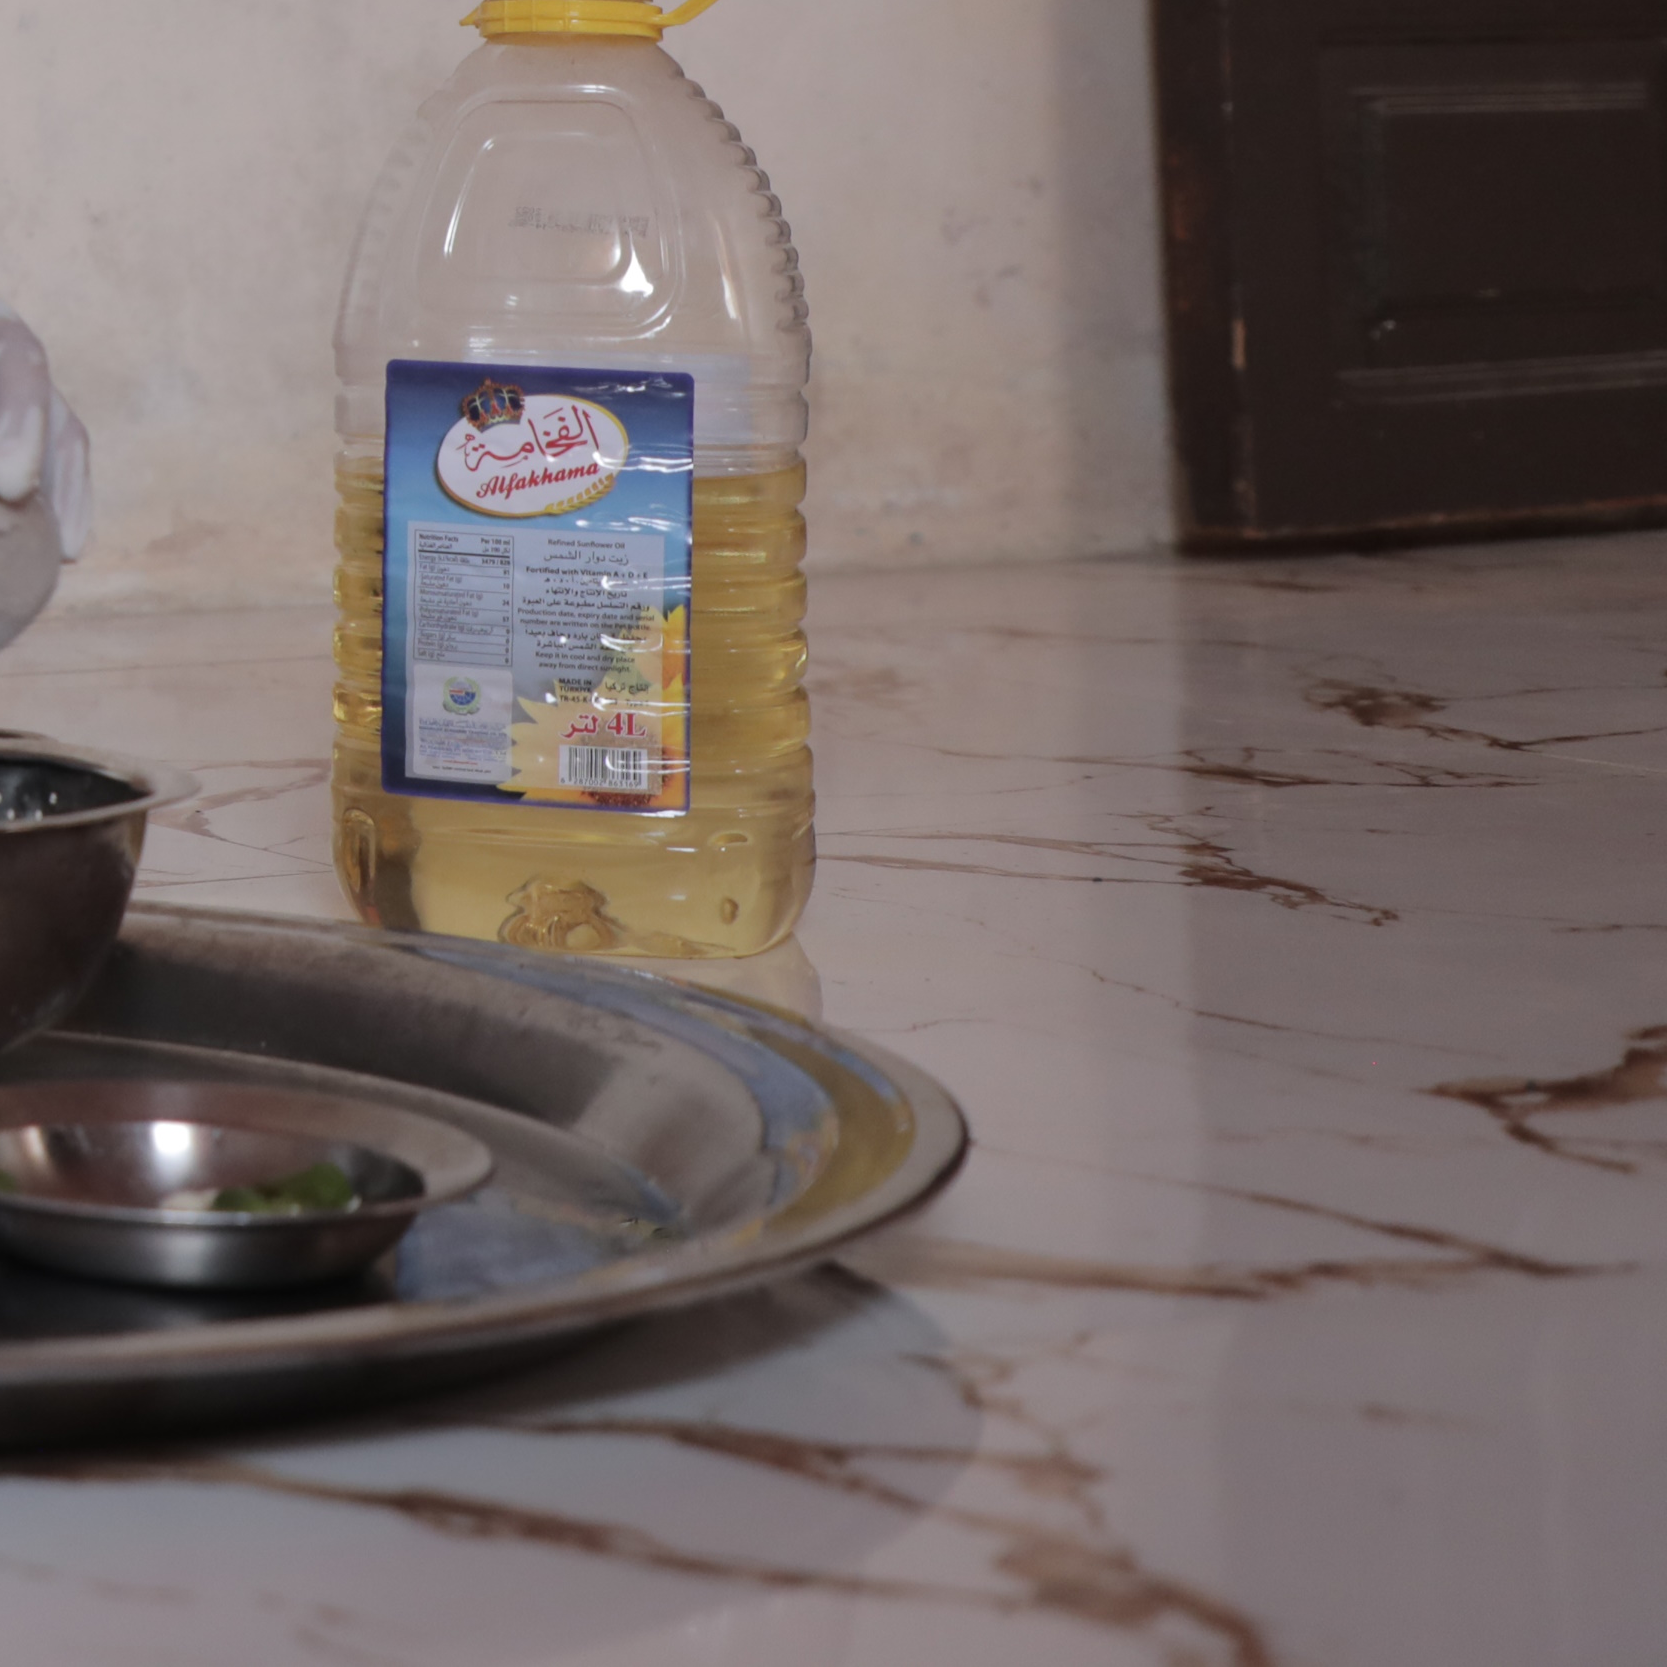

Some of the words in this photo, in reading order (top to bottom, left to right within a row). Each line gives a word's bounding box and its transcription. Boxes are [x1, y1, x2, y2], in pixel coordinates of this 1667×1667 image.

[476, 462, 599, 500] Alfakhama
[419, 534, 443, 542] Nutrition
[548, 539, 575, 548] Refined
[576, 540, 614, 549] Sunflower
[614, 541, 626, 549] Oil
[544, 549, 582, 562] الشمس
[585, 551, 606, 564] دوار
[608, 553, 629, 566] زيت
[526, 566, 560, 575] Fortified
[561, 567, 579, 576] with
[581, 569, 611, 577] Vitamin
[517, 607, 557, 617] Production
[578, 612, 600, 622] expiry
[601, 612, 618, 621] date
[620, 613, 635, 622] and
[635, 614, 655, 622] serial
[520, 618, 548, 626] number
[562, 620, 588, 628] written
[601, 621, 613, 629] the
[535, 651, 554, 660] Keep
[570, 652, 586, 661] cool
[587, 654, 601, 662] and
[602, 654, 615, 664] dry
[616, 655, 636, 665] place
[538, 662, 557, 671] away
[559, 661, 575, 670] from
[577, 661, 598, 671] direct
[558, 678, 582, 686] MADE
[604, 681, 627, 694] تركيا
[559, 714, 600, 739] لتر
[607, 711, 647, 737] 4L
[573, 777, 604, 787] 287002
